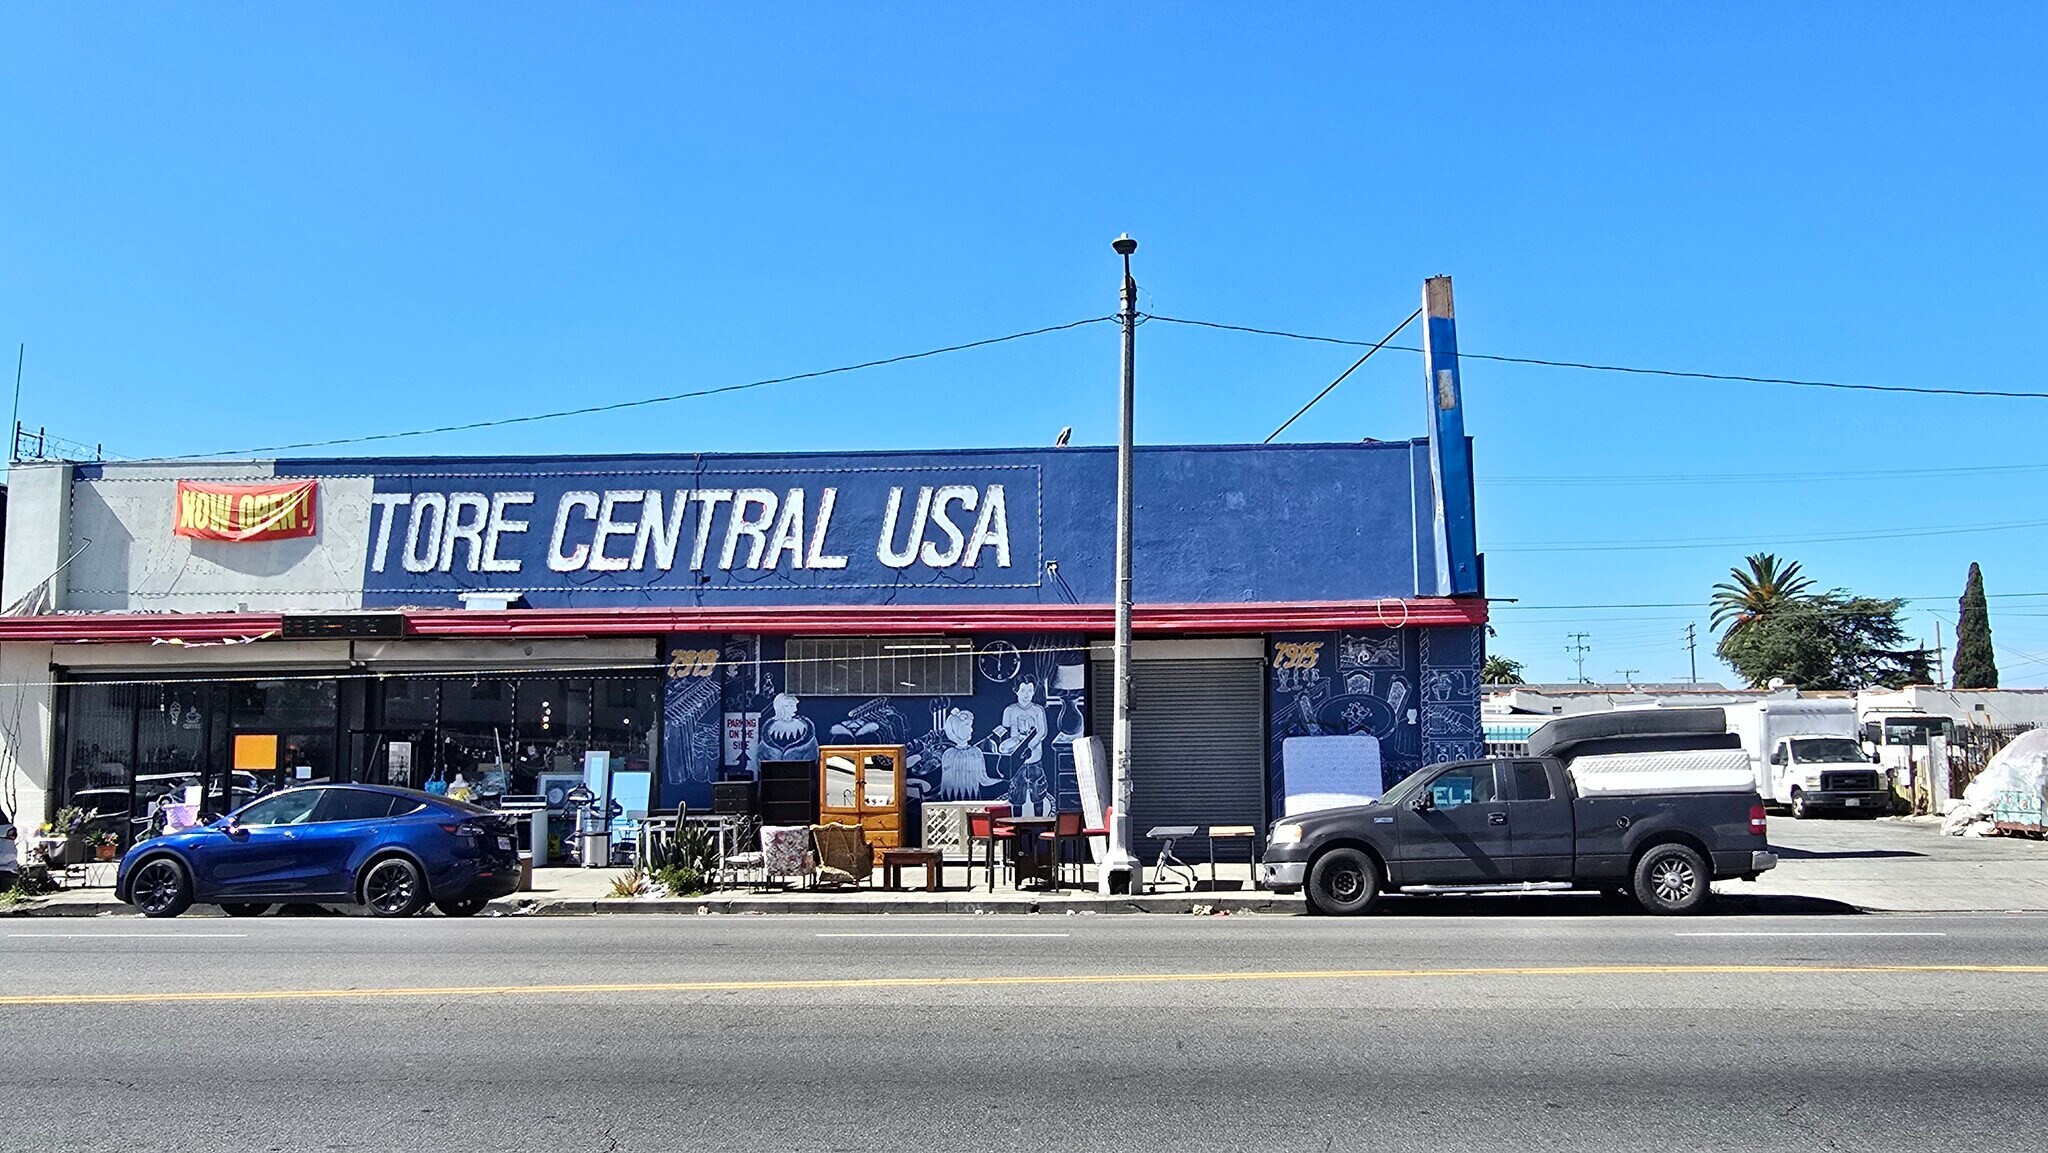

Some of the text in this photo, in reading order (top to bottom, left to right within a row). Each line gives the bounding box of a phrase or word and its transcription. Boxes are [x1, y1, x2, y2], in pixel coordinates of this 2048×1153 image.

[180, 490, 234, 532] NOW
[546, 487, 849, 572] CENTRAL
[876, 484, 1012, 569] USA
[667, 649, 720, 678] 7919
[1273, 641, 1325, 669] 7915
[726, 719, 757, 729] PARKNG
[729, 730, 739, 739] ON
[732, 740, 751, 750] SIE
